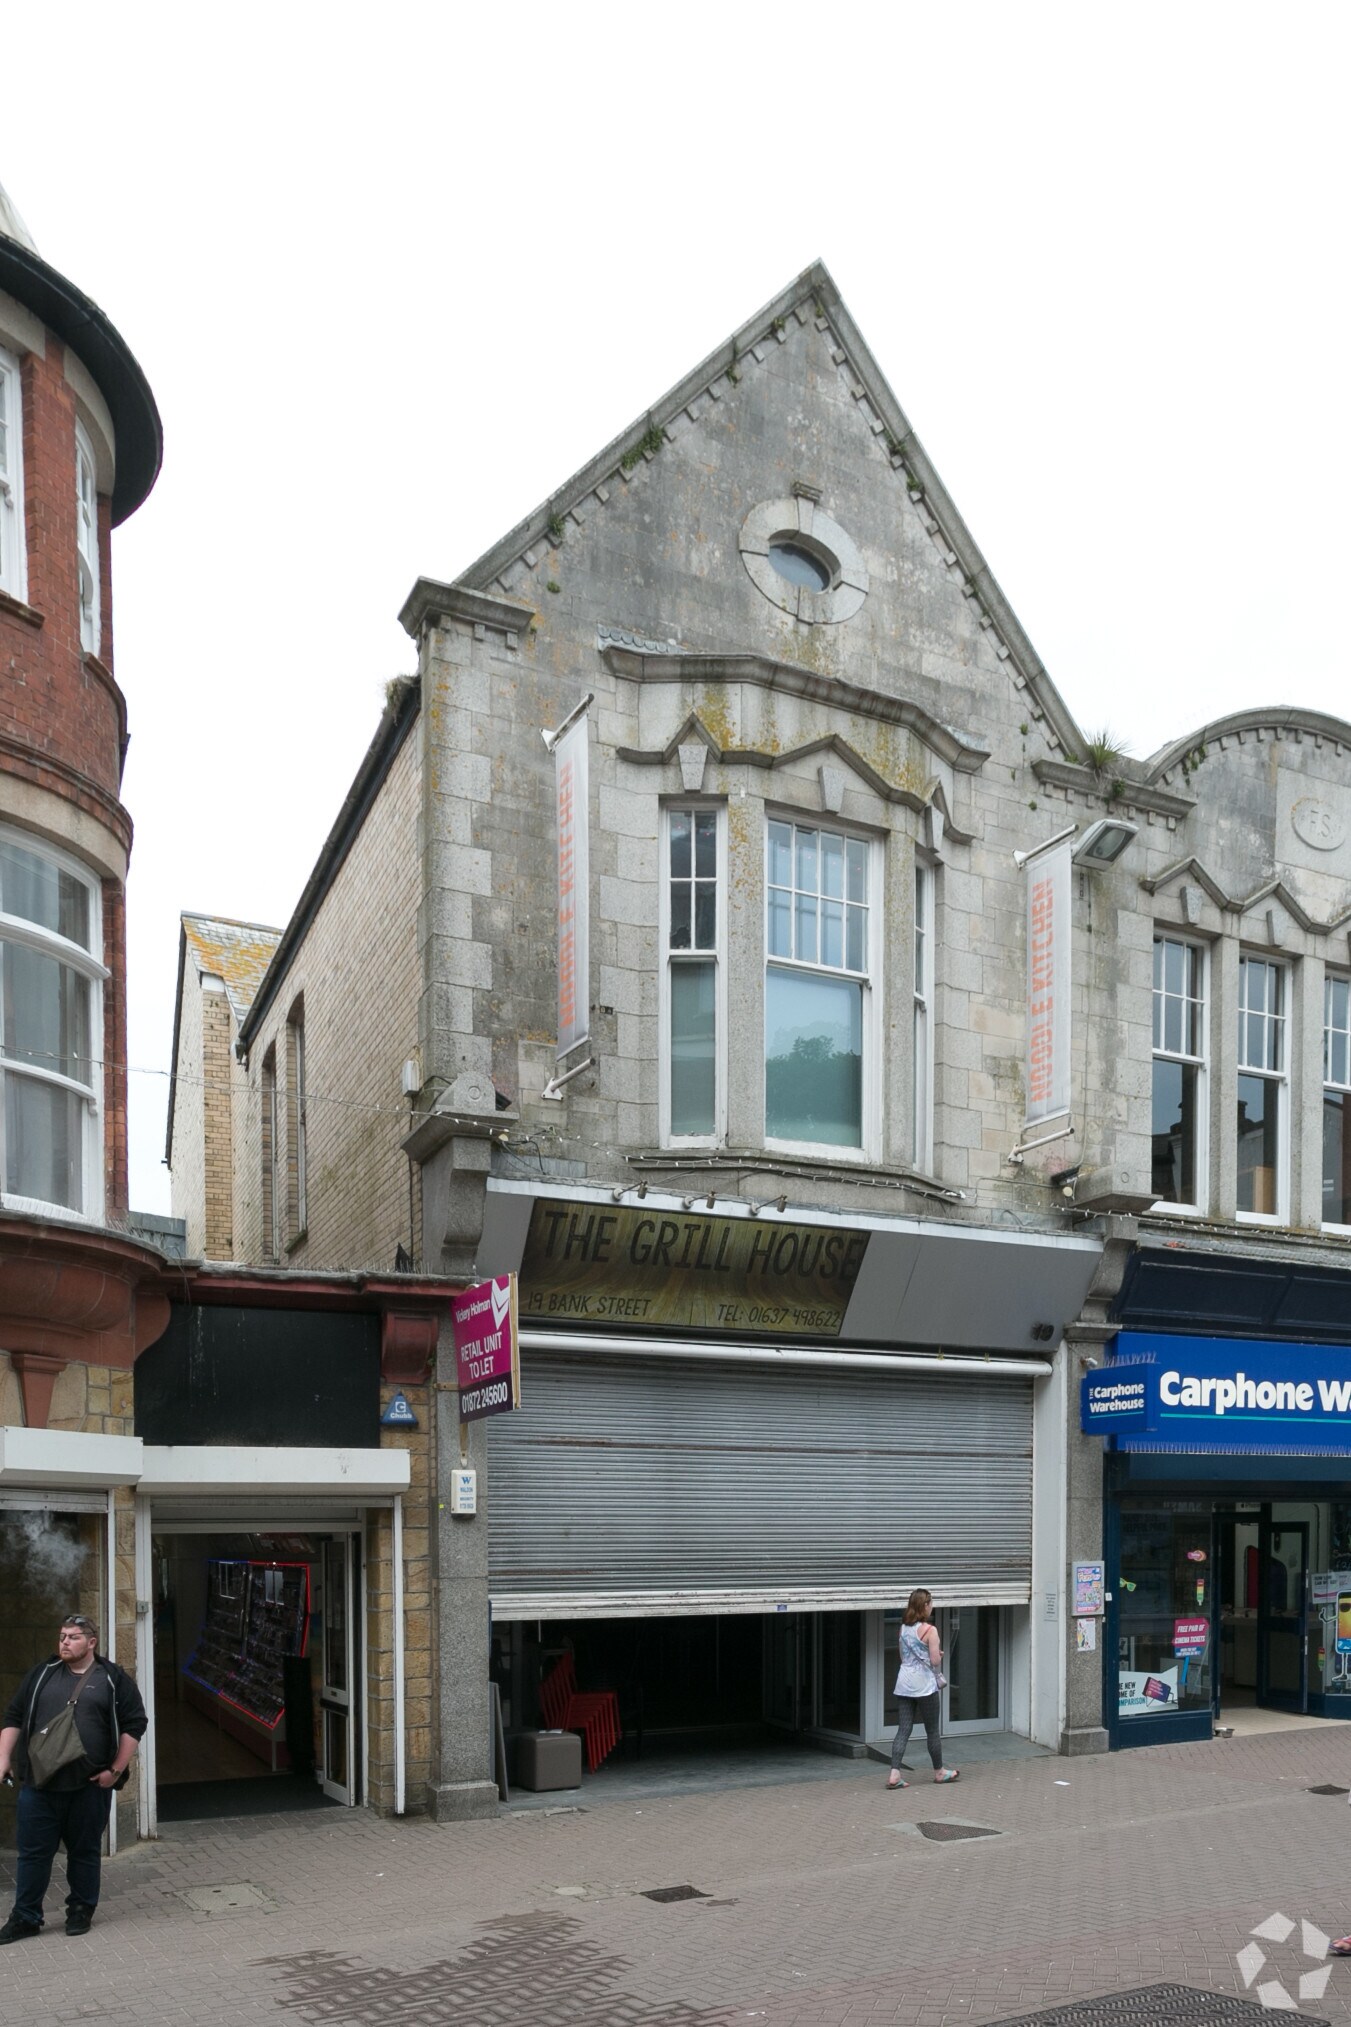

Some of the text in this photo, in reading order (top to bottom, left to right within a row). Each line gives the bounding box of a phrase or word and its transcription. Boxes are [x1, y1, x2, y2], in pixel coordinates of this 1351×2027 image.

[1030, 878, 1054, 1104] NOODLE KITCHEN
[545, 1211, 866, 1282] THE GRILL HOUSE
[528, 1291, 652, 1317] 19 BANK STREET
[717, 1304, 841, 1329] TEL: 01637 498622
[461, 1331, 502, 1363] RETAIL UNIT
[469, 1356, 494, 1379] TO LET
[462, 1382, 508, 1414] 01872 245600
[1094, 1383, 1145, 1400] Carphone
[1160, 1371, 1351, 1415] Carphone W
[1090, 1398, 1145, 1413] Warehouse
[1125, 1682, 1136, 1690] NEW
[1129, 1690, 1136, 1698] OF
